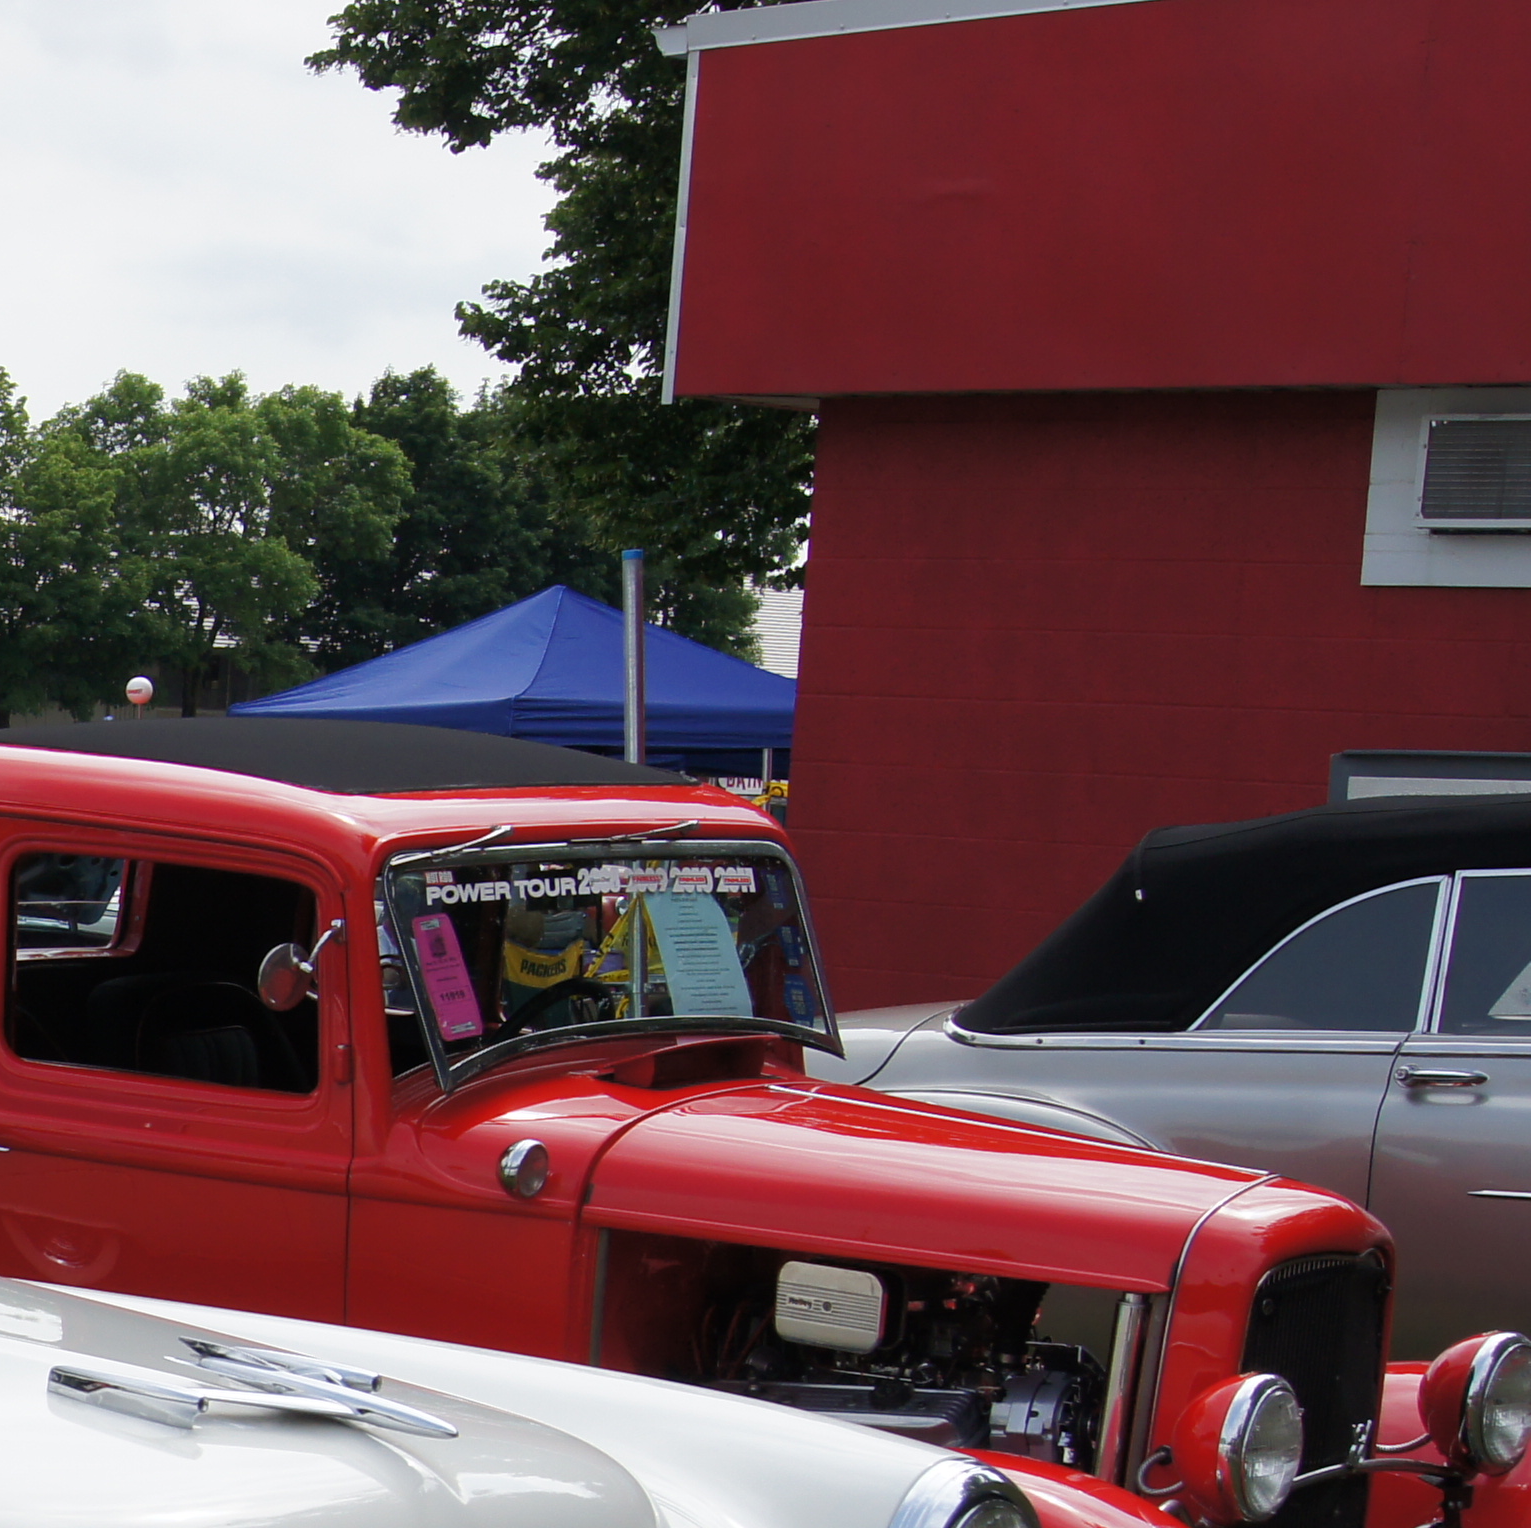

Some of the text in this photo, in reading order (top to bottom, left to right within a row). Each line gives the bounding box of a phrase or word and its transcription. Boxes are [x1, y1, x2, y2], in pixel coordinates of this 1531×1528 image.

[426, 876, 577, 906] POWER TOUR
[520, 958, 567, 978] PACKERS
